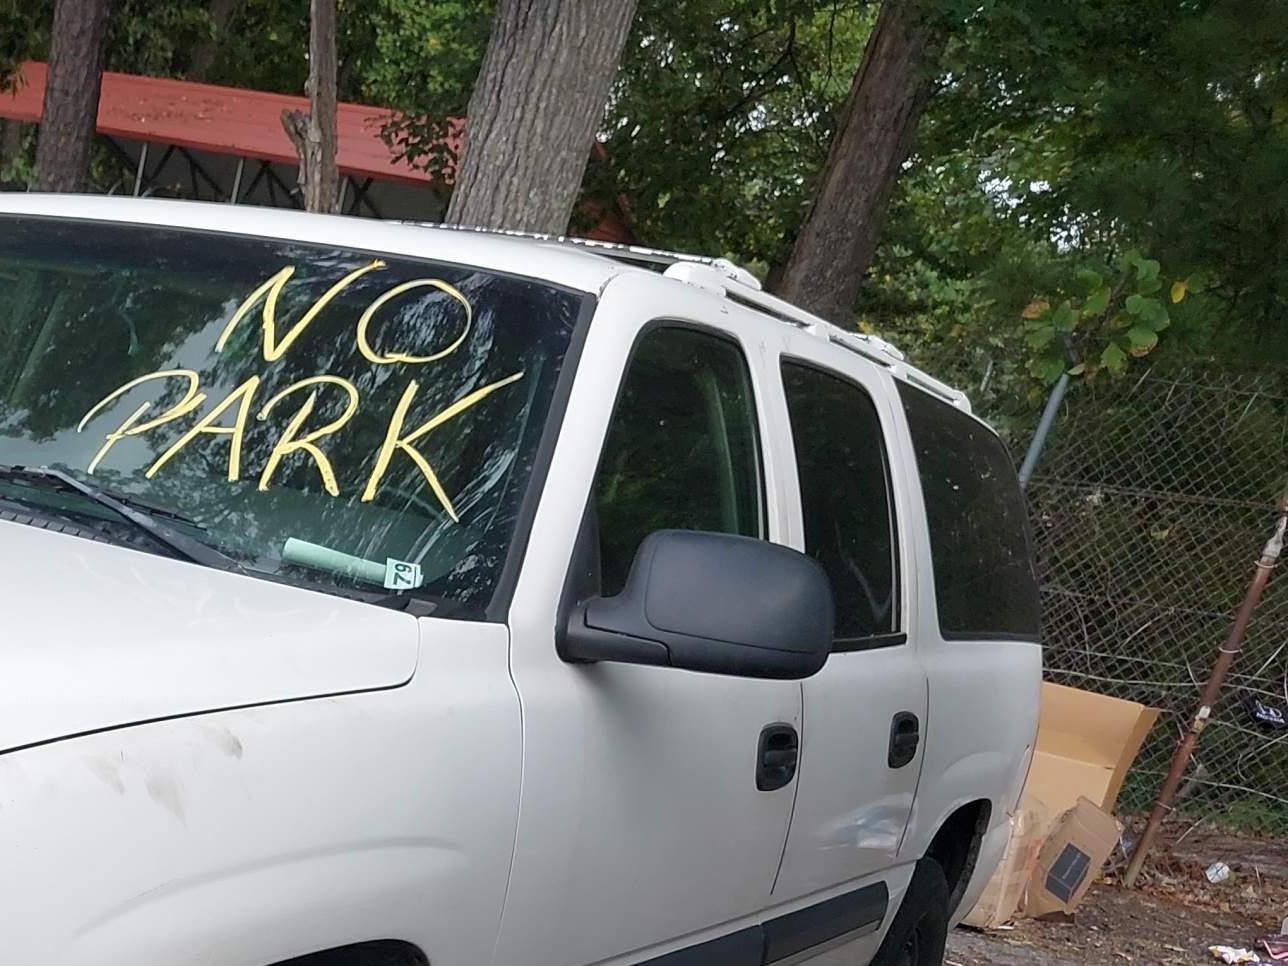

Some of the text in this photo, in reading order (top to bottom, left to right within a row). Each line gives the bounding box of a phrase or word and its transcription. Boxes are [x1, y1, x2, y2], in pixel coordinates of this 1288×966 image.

[215, 258, 473, 364] NO
[77, 369, 524, 523] PARK
[393, 563, 412, 586] 79
